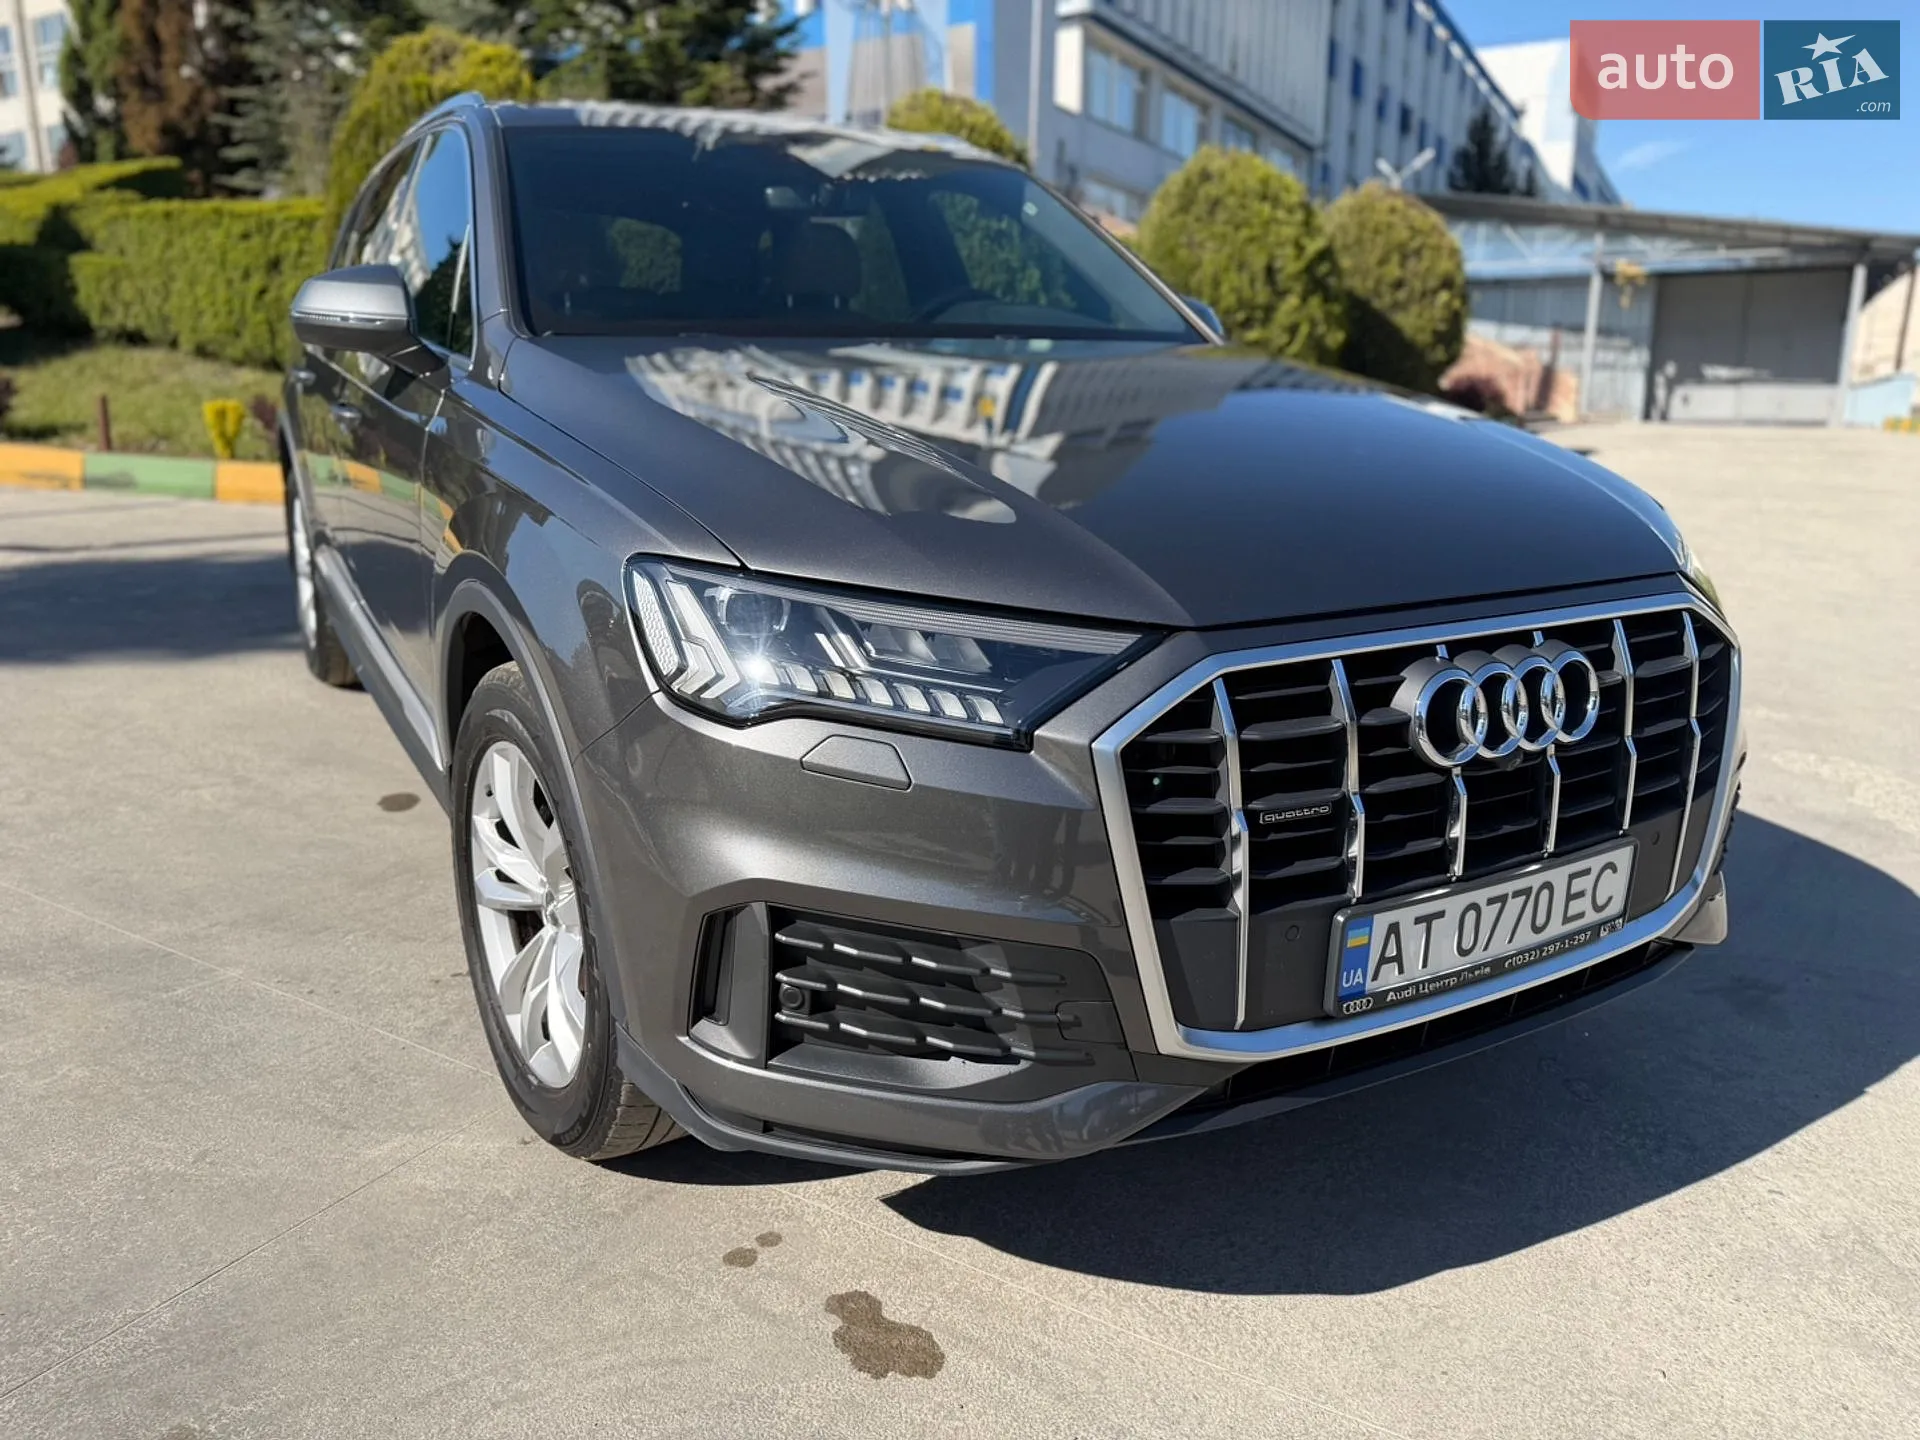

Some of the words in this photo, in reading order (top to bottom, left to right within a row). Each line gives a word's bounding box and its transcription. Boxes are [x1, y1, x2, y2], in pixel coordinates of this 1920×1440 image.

[1263, 804, 1330, 822] quattro
[1370, 909, 1446, 982] AT
[1454, 880, 1555, 958] 0770
[1560, 860, 1619, 926] EC
[1511, 949, 1540, 966] (032)
[1342, 967, 1364, 988] UA
[1386, 985, 1416, 1002] Audi
